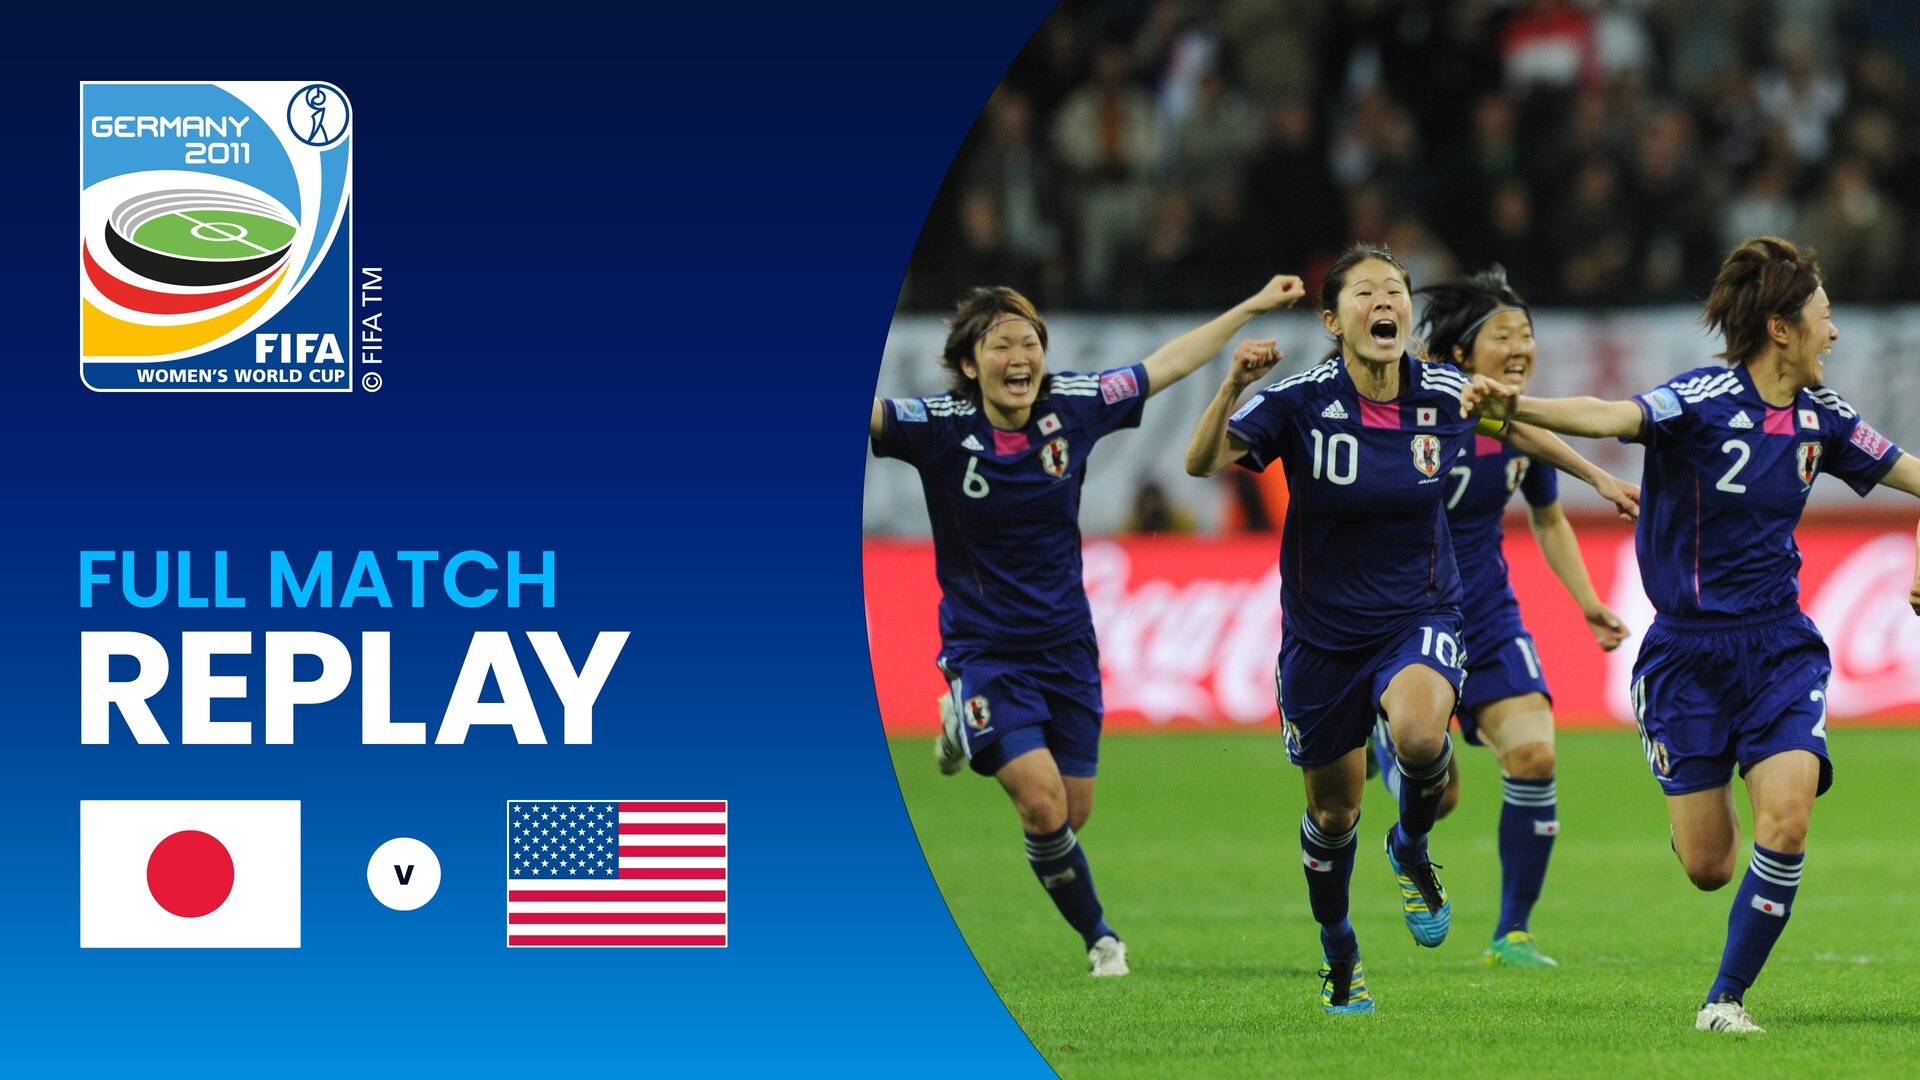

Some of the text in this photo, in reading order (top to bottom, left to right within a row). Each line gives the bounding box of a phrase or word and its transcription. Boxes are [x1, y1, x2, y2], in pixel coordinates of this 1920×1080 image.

[962, 456, 990, 499] 6
[1310, 428, 1359, 486] 10
[1715, 439, 1751, 494] 2
[1420, 626, 1458, 669] 10
[1515, 637, 1541, 680] 1
